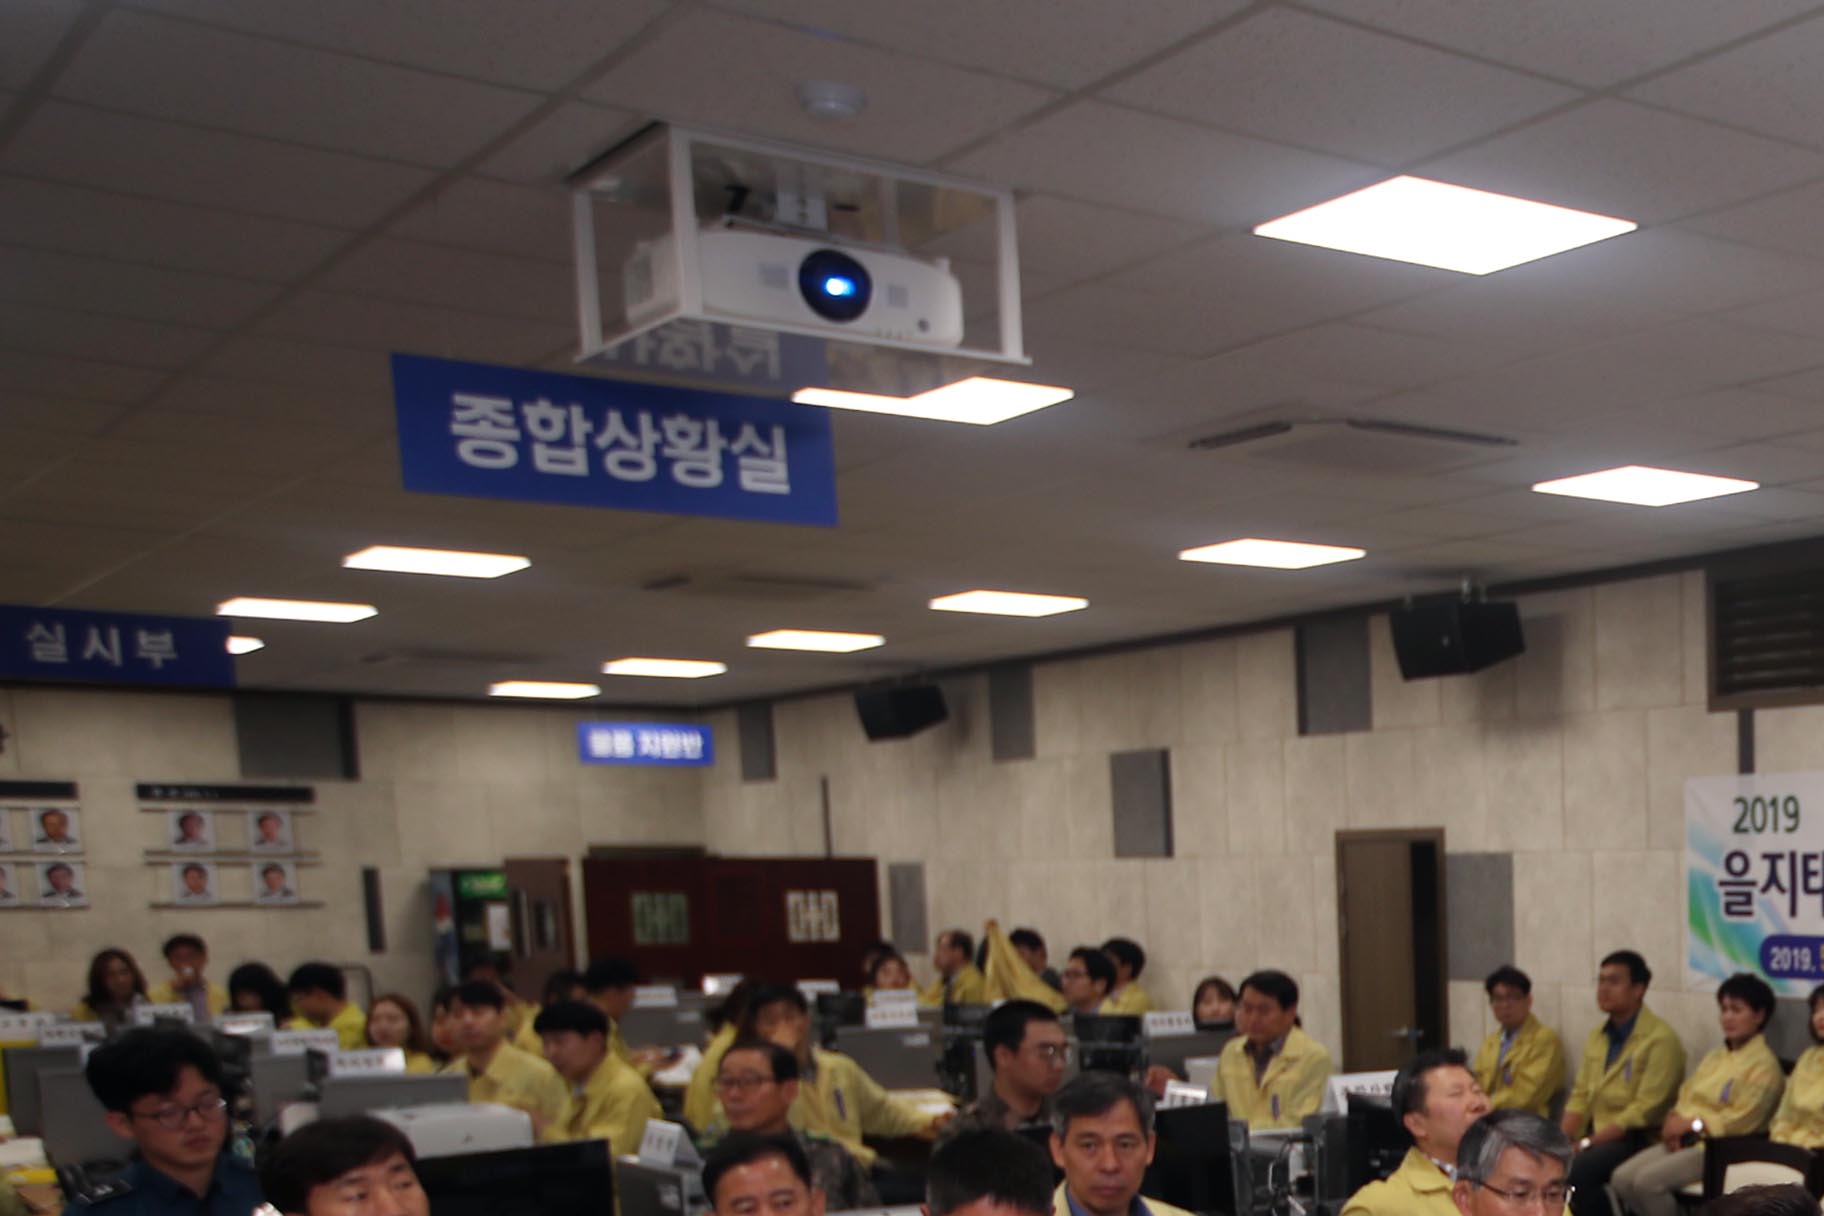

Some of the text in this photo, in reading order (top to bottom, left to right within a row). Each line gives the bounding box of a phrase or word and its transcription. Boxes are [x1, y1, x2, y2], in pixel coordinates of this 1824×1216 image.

[450, 393, 792, 495] 종합상황실
[1733, 795, 1800, 834] 2019
[1769, 946, 1816, 973] 2019.
